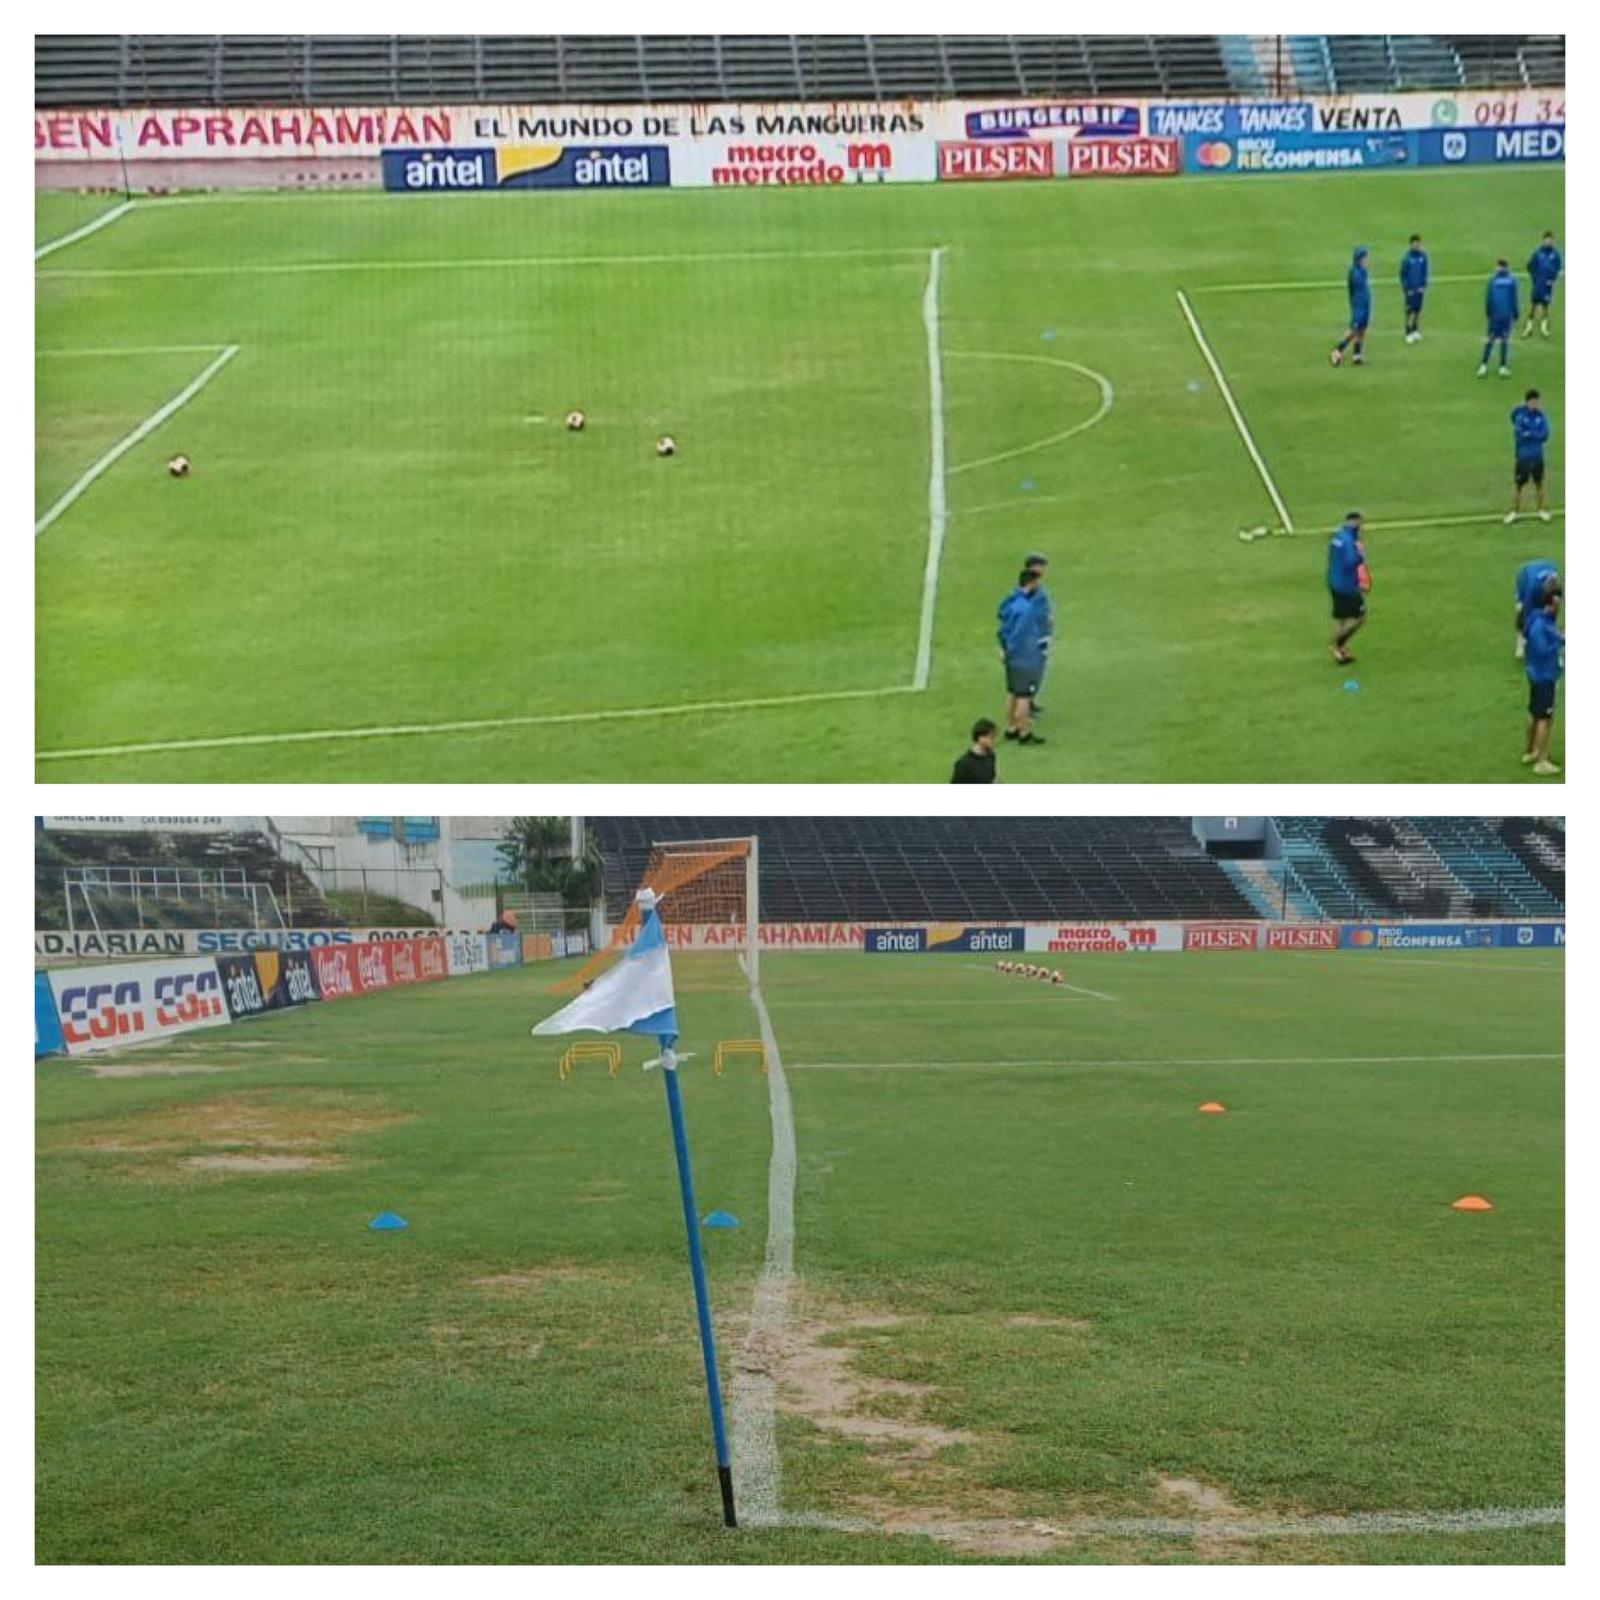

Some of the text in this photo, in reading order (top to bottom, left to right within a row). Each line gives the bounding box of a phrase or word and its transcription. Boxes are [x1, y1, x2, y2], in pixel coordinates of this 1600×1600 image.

[474, 113, 925, 138] EL MUNDO DE LAS MANGUERAS
[1319, 107, 1403, 130] VENTA
[1474, 100, 1519, 125] 091
[727, 143, 816, 163] macro
[943, 143, 1171, 174] PILSEN PILSEN
[406, 150, 650, 187] antel antel
[712, 159, 845, 186] mercado
[876, 930, 1012, 950] antel antel
[1187, 929, 1333, 947] PILSEN PILSEN
